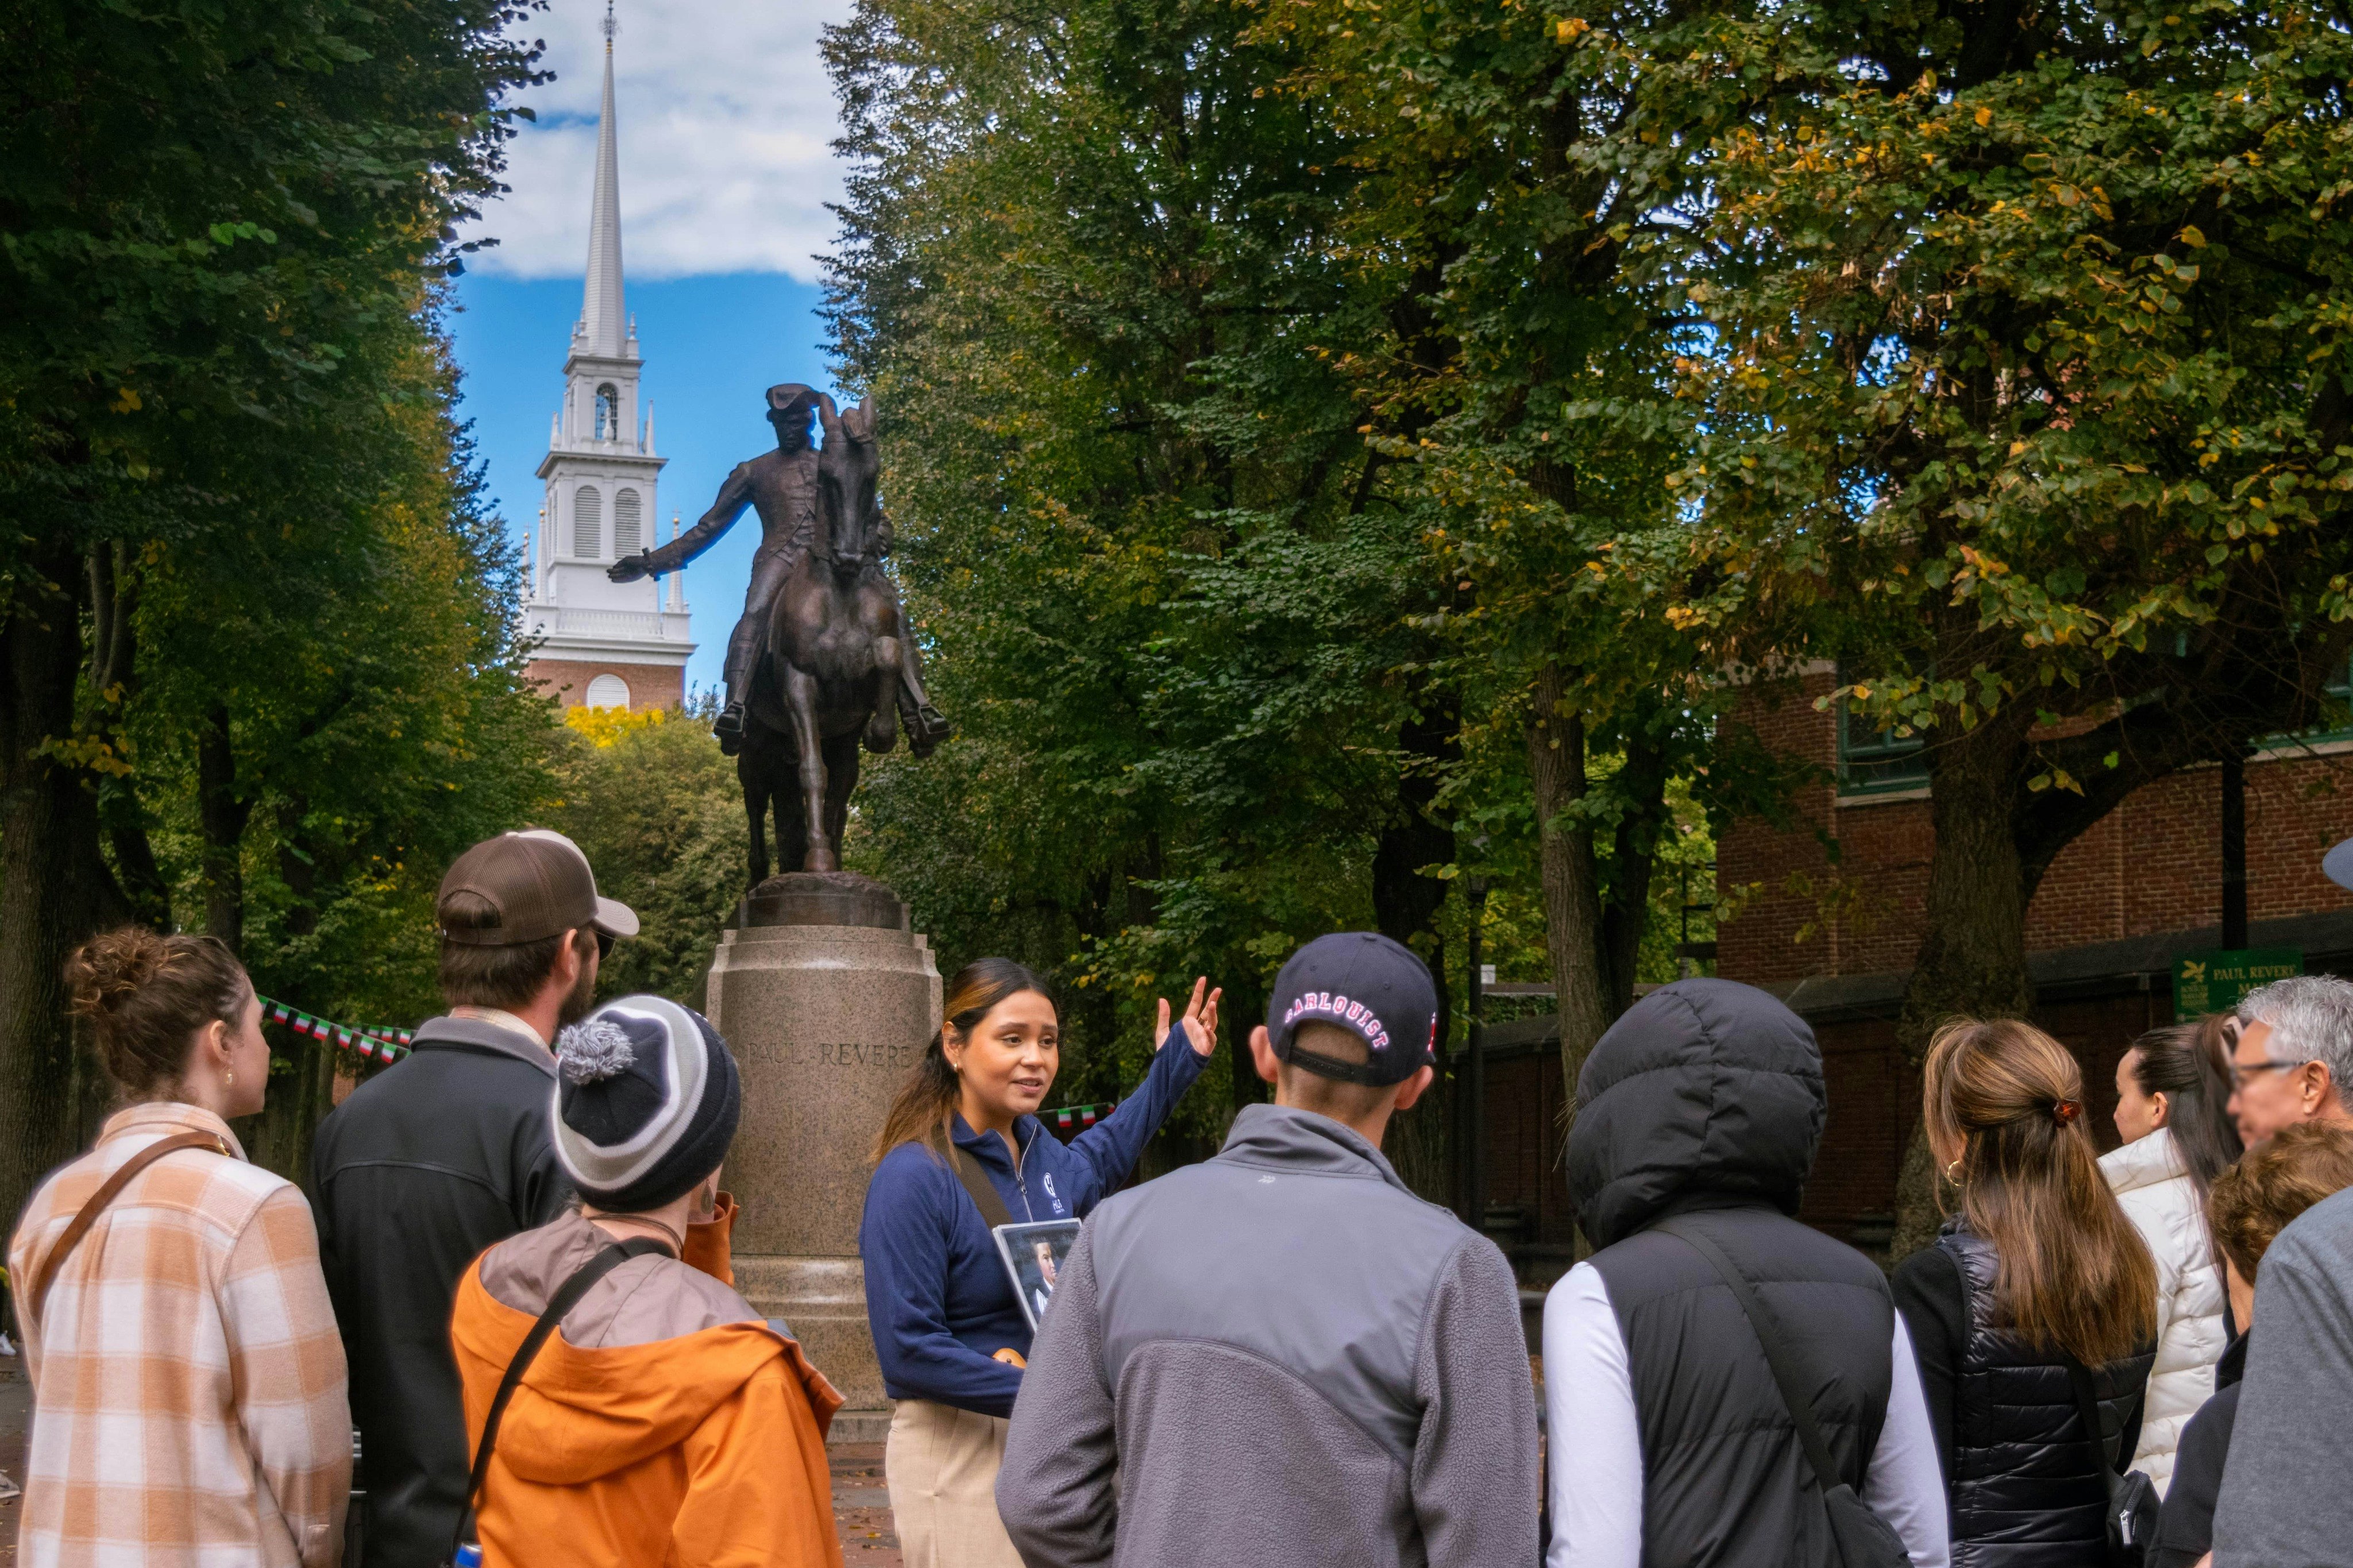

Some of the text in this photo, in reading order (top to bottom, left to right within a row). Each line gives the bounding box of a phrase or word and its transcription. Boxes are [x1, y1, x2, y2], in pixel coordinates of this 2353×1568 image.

[2213, 968, 2246, 980] PAUL
[748, 1042, 915, 1067] PAUL REVERE
